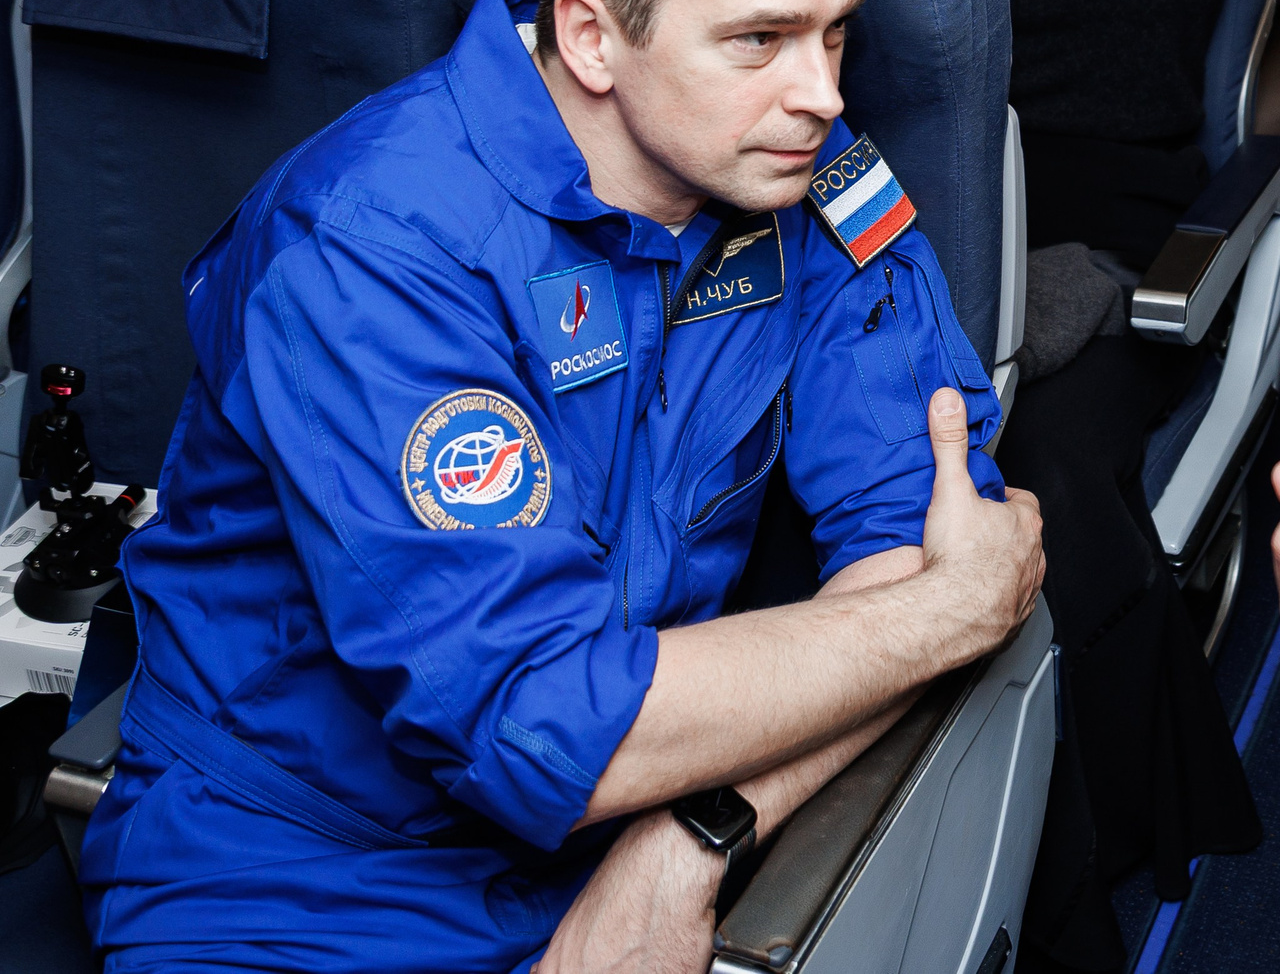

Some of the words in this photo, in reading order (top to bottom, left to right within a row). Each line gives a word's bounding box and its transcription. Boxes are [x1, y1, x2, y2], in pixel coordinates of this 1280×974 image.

[813, 143, 878, 202] РОССИЯ
[551, 340, 623, 381] РОСКОСМОС
[409, 432, 431, 473] ЦЕНТР
[422, 395, 487, 437] ПОДГОТОВКИ
